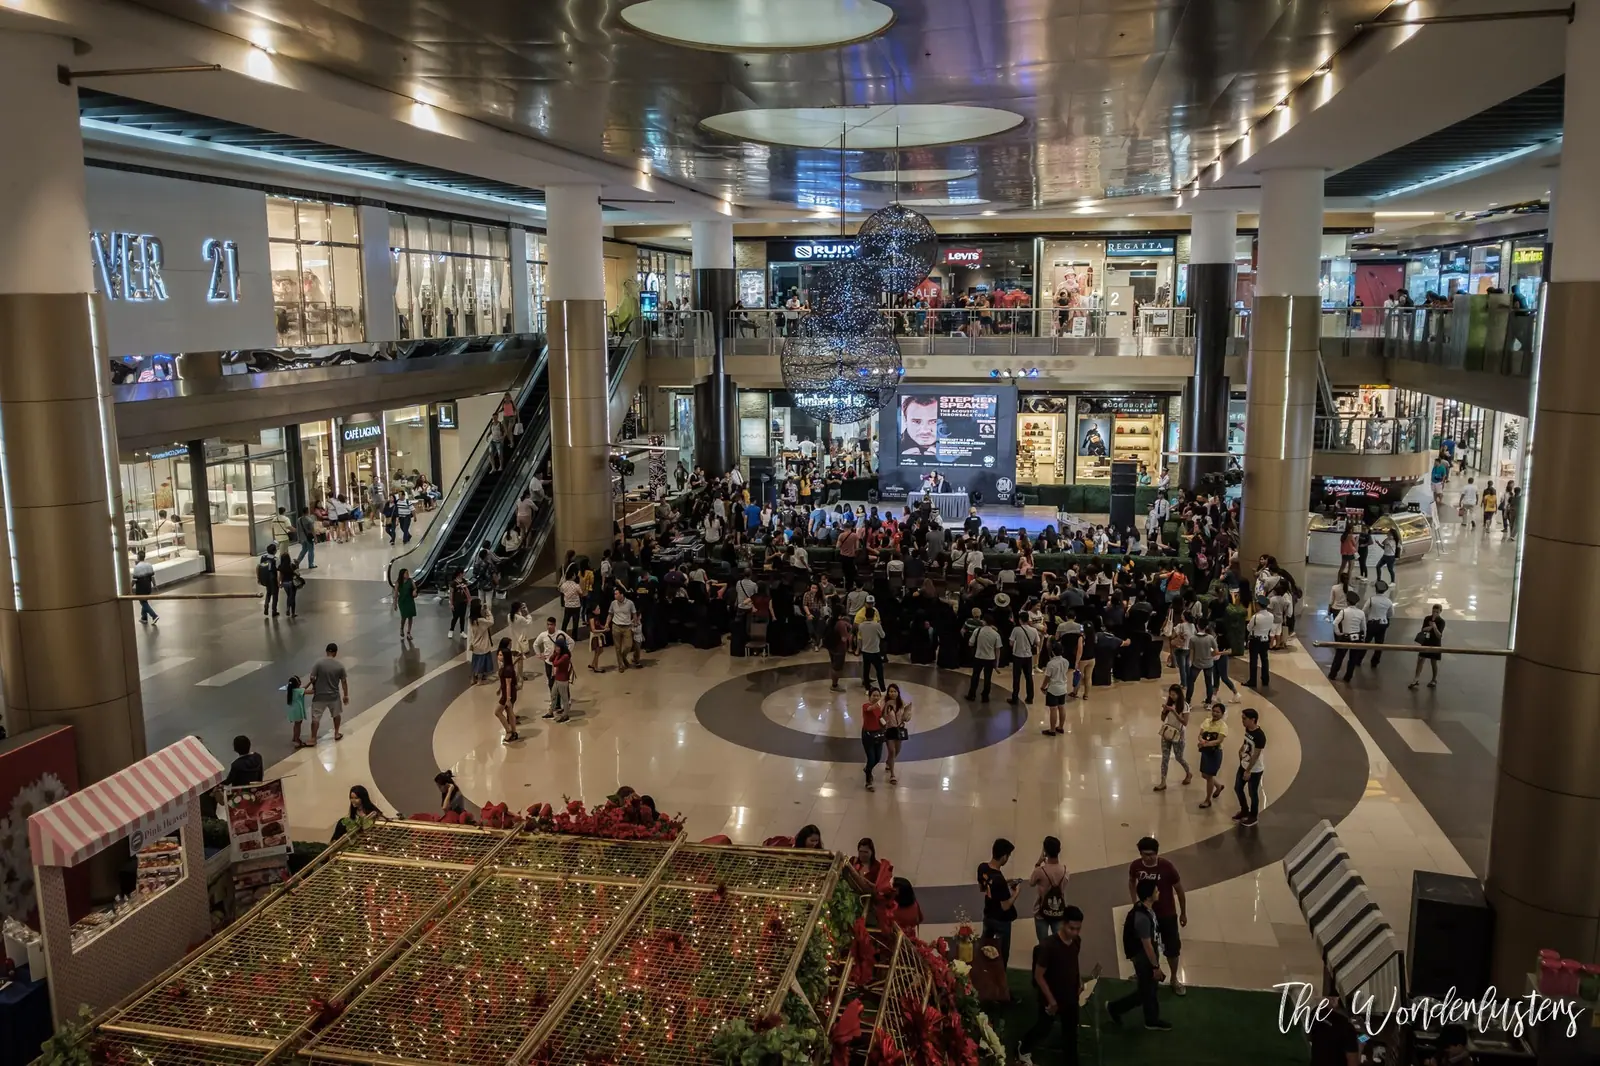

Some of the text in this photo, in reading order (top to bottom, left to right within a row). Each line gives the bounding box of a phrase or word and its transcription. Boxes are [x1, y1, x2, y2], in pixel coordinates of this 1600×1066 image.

[813, 245, 861, 254] RUDY
[1108, 242, 1163, 251] REGATTA
[202, 238, 242, 302] 21
[907, 288, 938, 298] SALE
[1110, 292, 1120, 306] 2
[440, 406, 451, 423] L
[344, 425, 382, 440] CAFÉ LAGUNA
[144, 811, 188, 840] Pink Heaven
